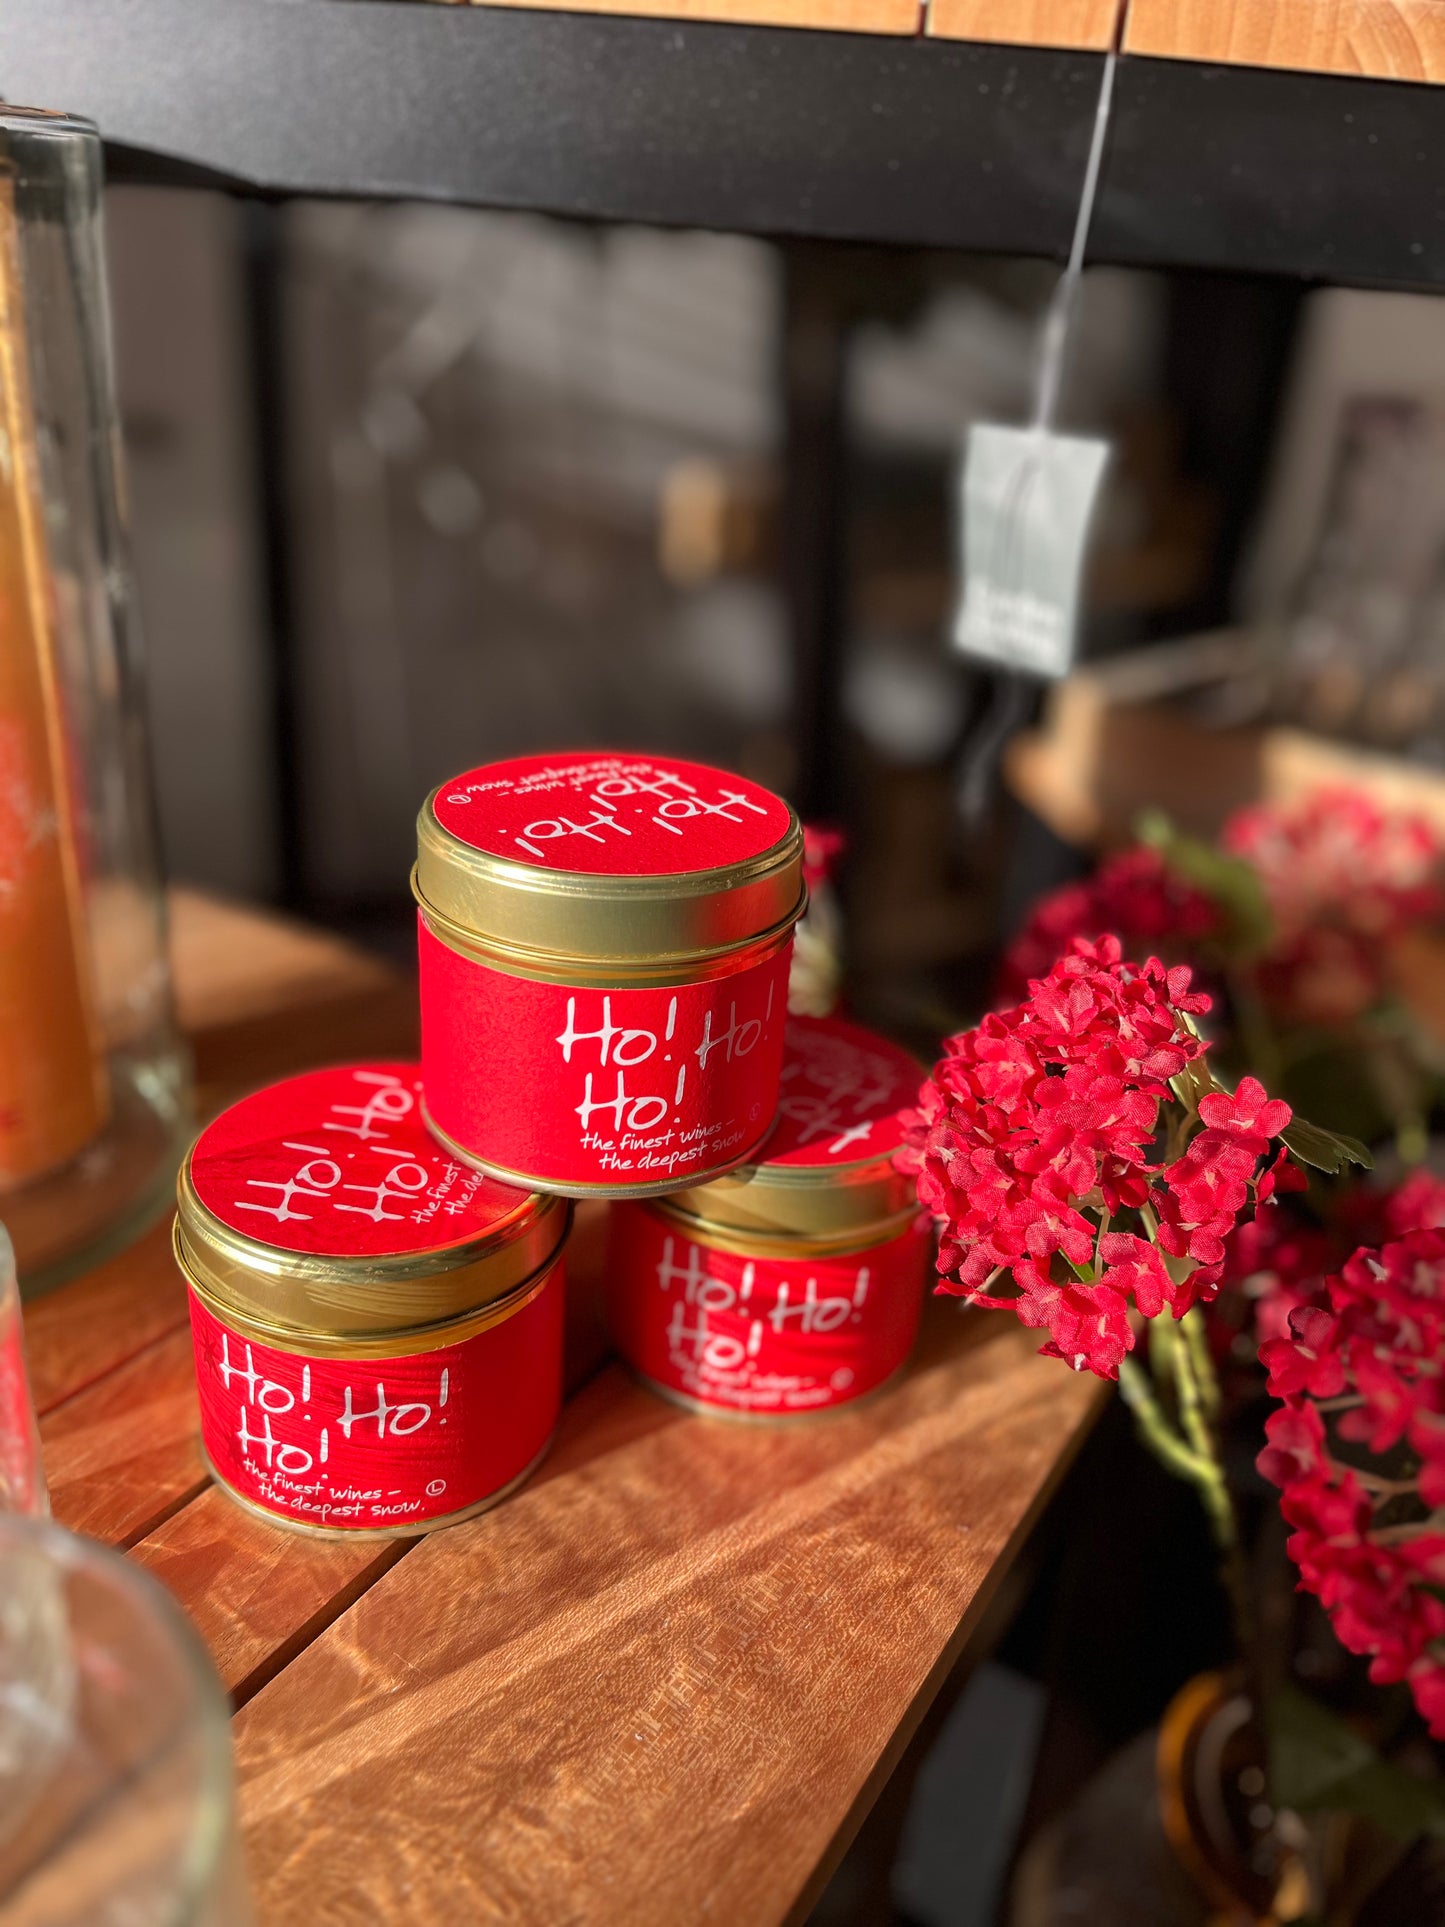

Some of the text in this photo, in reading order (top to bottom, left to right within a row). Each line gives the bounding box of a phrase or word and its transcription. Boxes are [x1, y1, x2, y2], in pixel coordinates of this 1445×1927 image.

[513, 780, 566, 795] wines
[575, 769, 698, 812] Ho!
[498, 789, 768, 858] Ho! Ho!
[555, 995, 678, 1068] Ho!
[694, 979, 774, 1070] Ho!
[574, 1064, 687, 1132] Ho!
[234, 1070, 424, 1223] Ho! Ho!
[579, 1132, 616, 1151] the
[619, 1128, 675, 1150] finest
[679, 1122, 722, 1144] wines
[598, 1152, 635, 1171] the
[637, 1141, 708, 1174] deepest
[333, 1146, 440, 1223] Ho!
[410, 1162, 462, 1224] the finest
[443, 1193, 474, 1216] the
[656, 1235, 870, 1334] Ho! Ho!
[666, 1301, 764, 1372] Ho!
[219, 1333, 449, 1439] Ho! Ho!
[236, 1405, 329, 1480] Ho!
[243, 1457, 270, 1481] the
[273, 1472, 325, 1496] finest
[329, 1485, 382, 1500] wines
[258, 1482, 425, 1522] the deepest snow.
